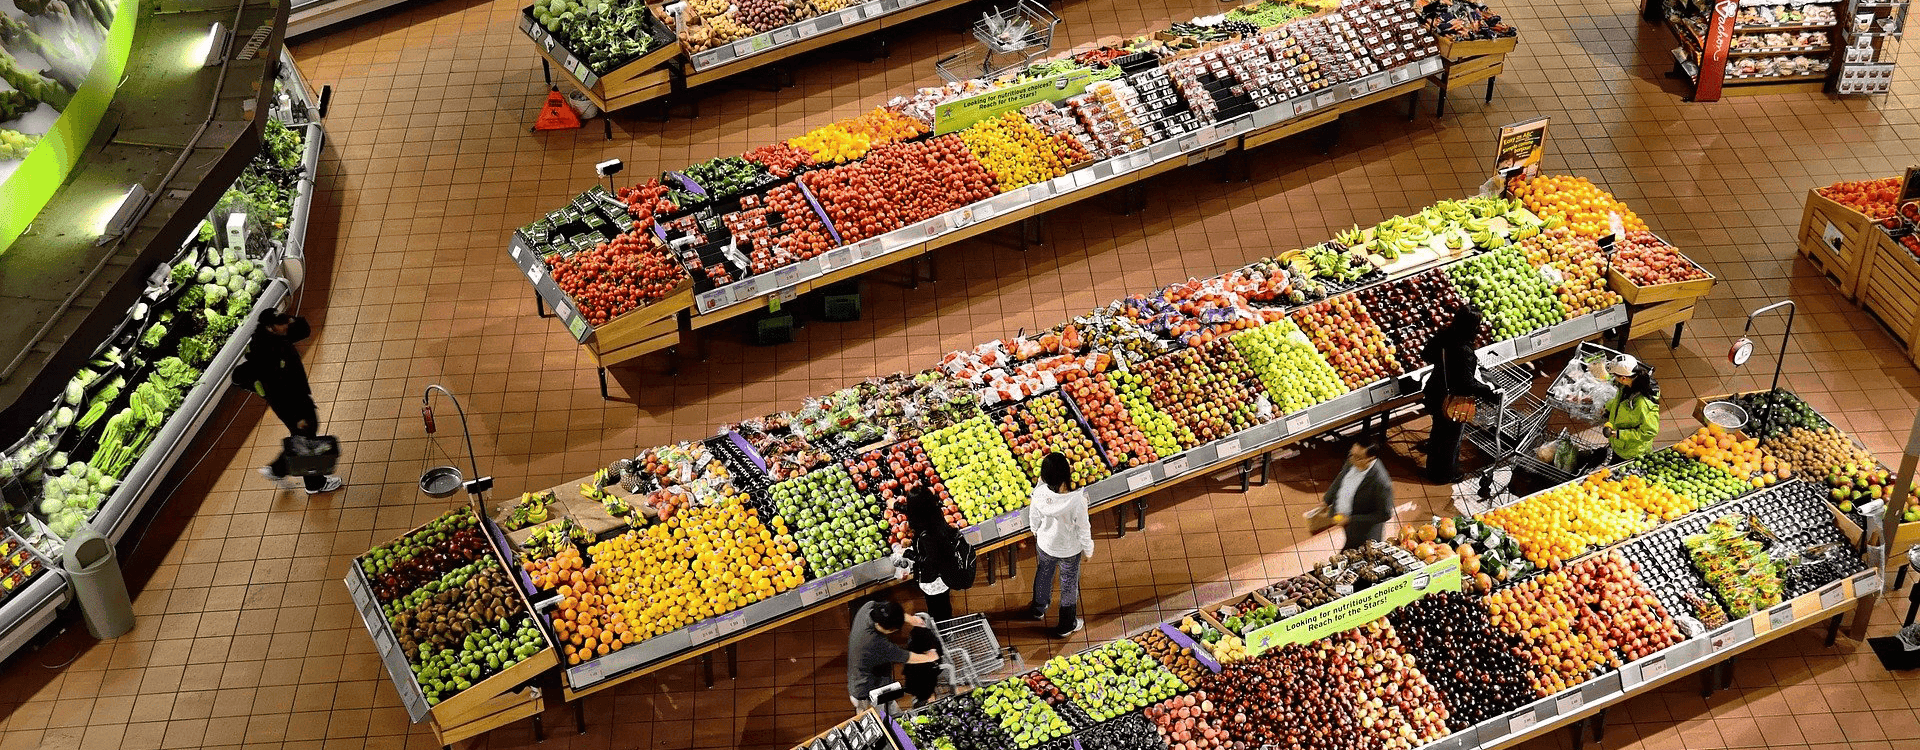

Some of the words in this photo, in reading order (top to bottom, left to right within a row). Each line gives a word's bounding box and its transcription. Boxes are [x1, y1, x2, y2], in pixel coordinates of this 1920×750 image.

[1714, 0, 1734, 61] Vachon
[963, 97, 986, 108] Looking
[998, 88, 1026, 99] nutritious
[1028, 81, 1053, 91] choices?
[979, 100, 997, 110] Reach
[1008, 95, 1018, 103] the
[1020, 91, 1037, 100] Stars!
[1286, 615, 1317, 631] Looking
[1319, 610, 1331, 619] for
[1333, 595, 1372, 614] nutritious
[1374, 580, 1408, 598] choices?
[1308, 618, 1333, 631] Reach
[1335, 612, 1346, 621] for
[1348, 607, 1361, 616] the
[1364, 596, 1388, 610] Stars!
